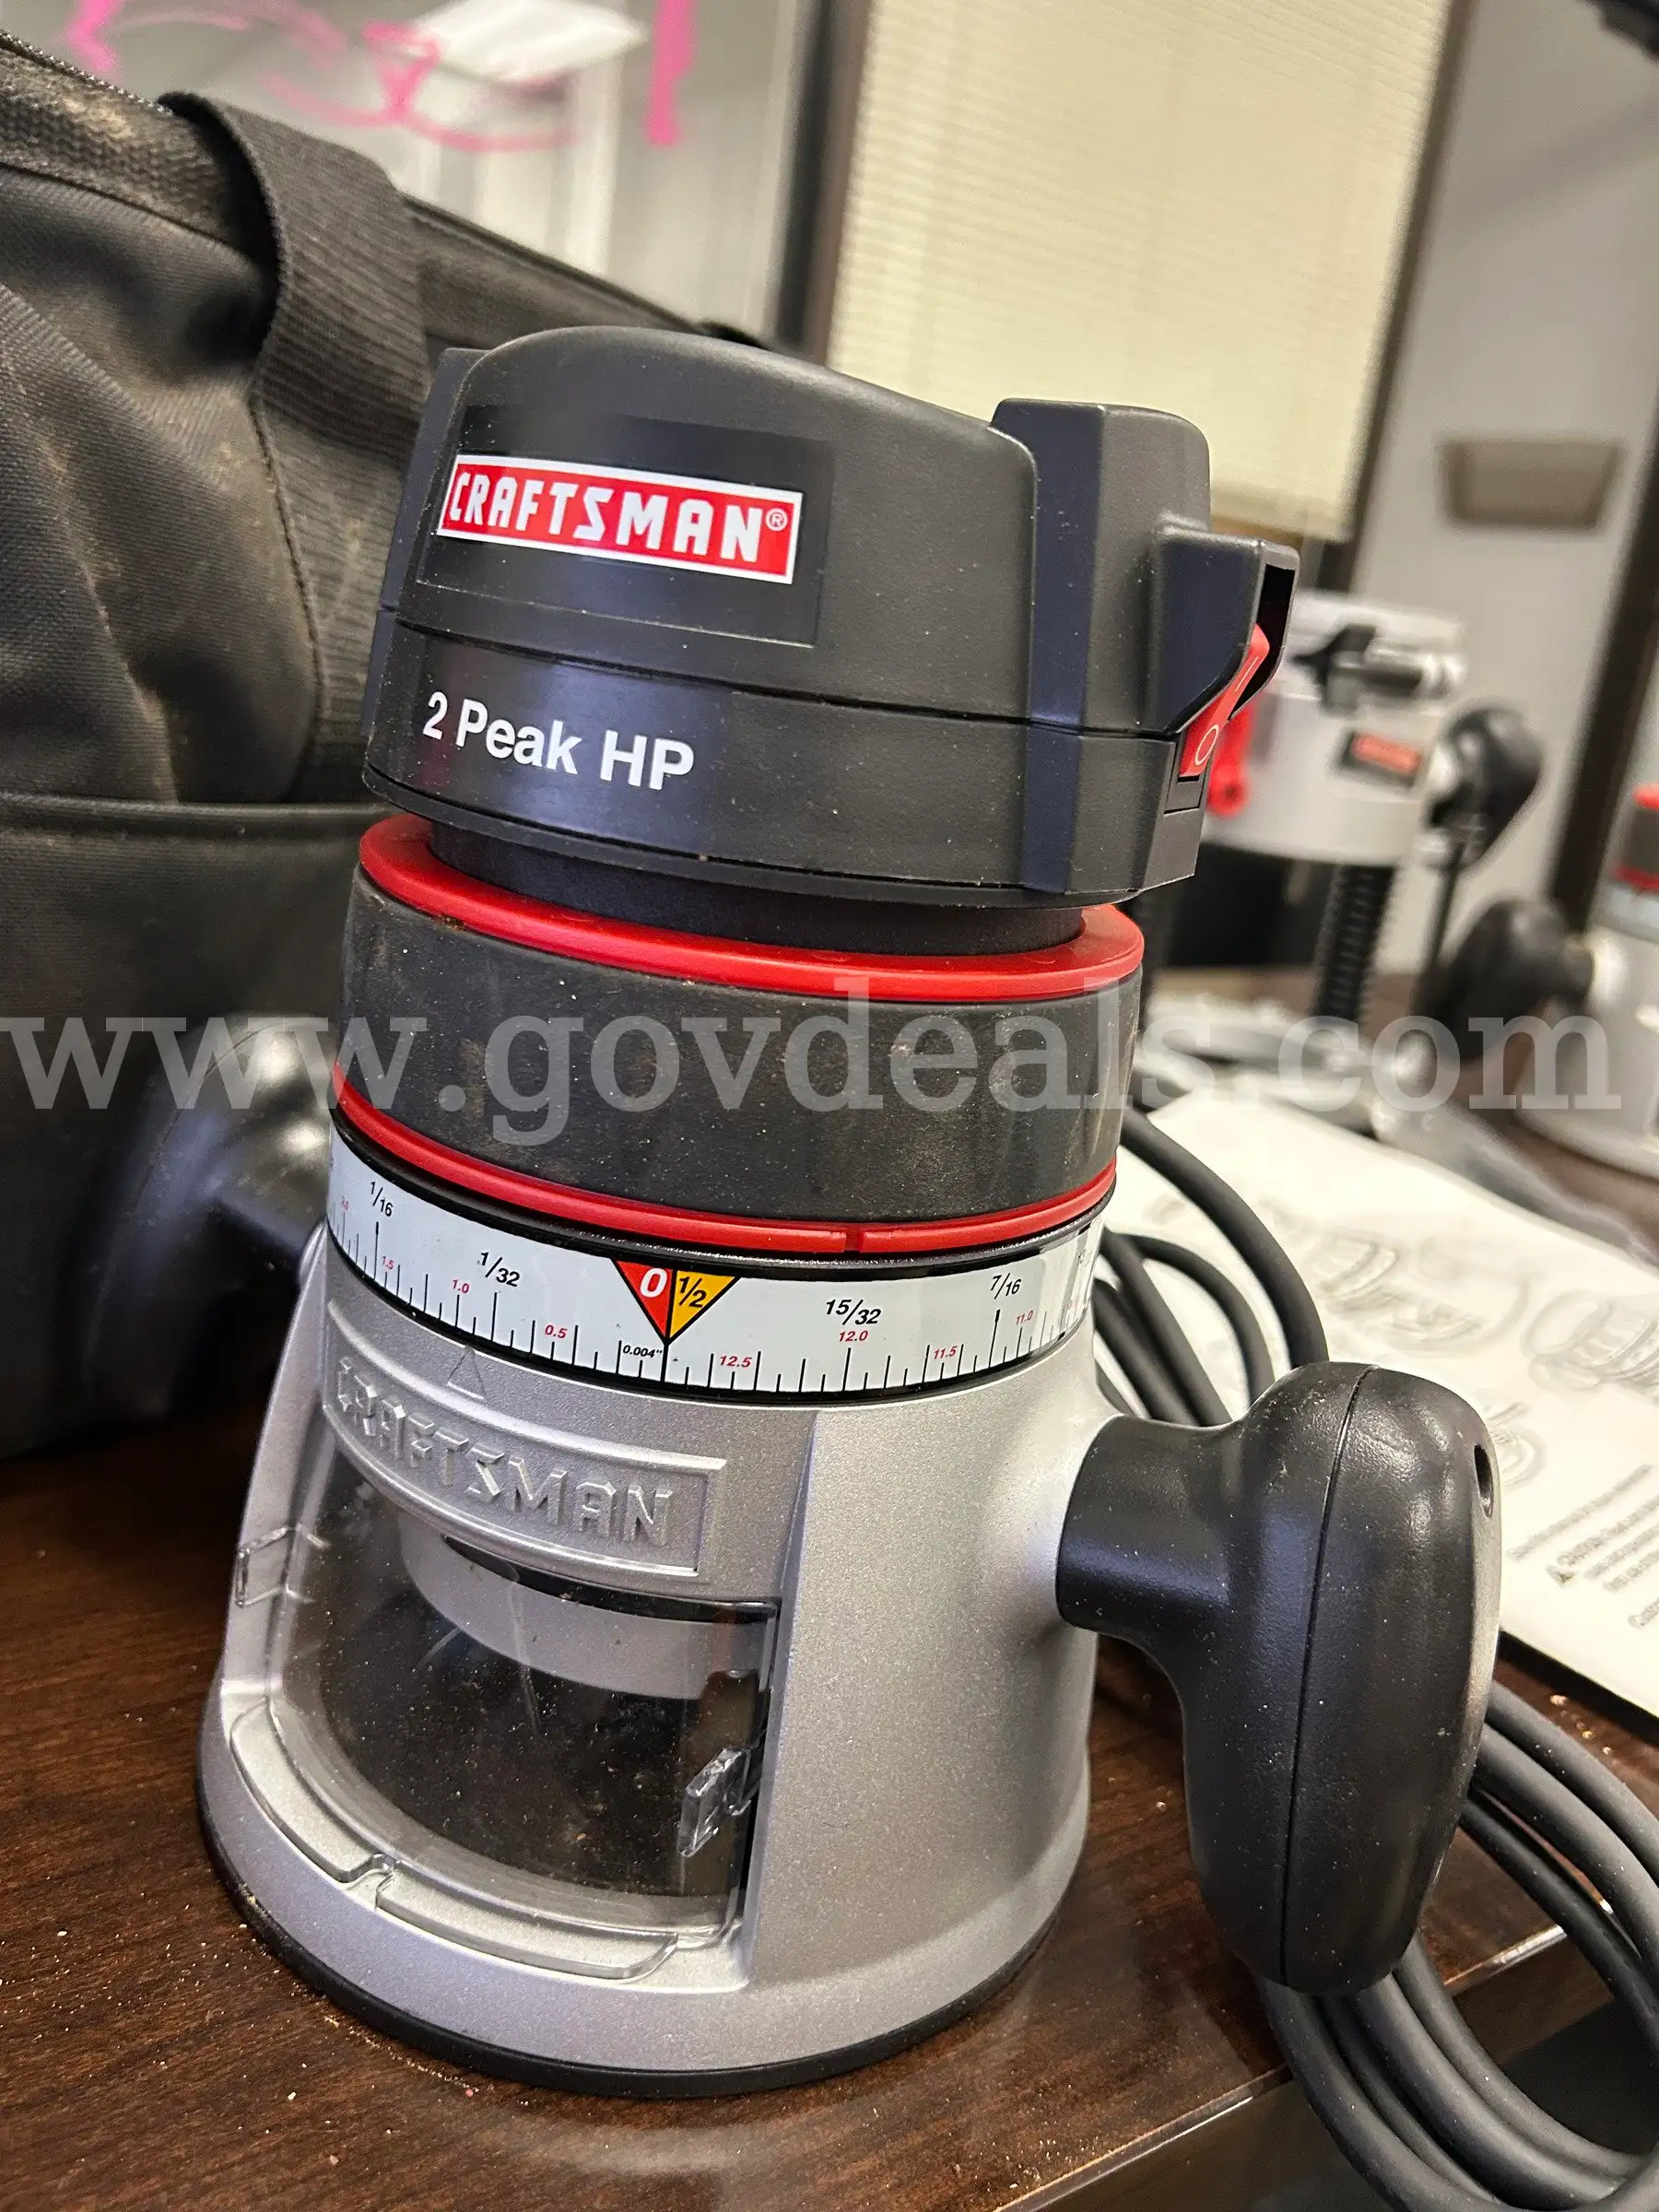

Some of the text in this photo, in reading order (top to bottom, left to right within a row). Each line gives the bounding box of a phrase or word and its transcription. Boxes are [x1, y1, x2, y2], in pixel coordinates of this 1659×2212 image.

[422, 691, 694, 790] 2 Peak HP
[370, 1181, 394, 1218] 1/16
[382, 1255, 394, 1269] 1.5
[478, 1251, 521, 1288] 1/32
[452, 1277, 470, 1295] 1.0
[640, 1267, 668, 1298] 0
[678, 1276, 707, 1309] 1/2
[990, 1273, 1022, 1300] 7/16
[825, 1298, 882, 1326] 15/32
[1016, 1310, 1034, 1325] 11.0
[544, 1324, 568, 1340] 0.5
[838, 1330, 869, 1342] 12.0
[719, 1355, 753, 1369] 12.5
[933, 1346, 958, 1360] 11.5
[337, 1356, 674, 1546] CRAFTSMAN
